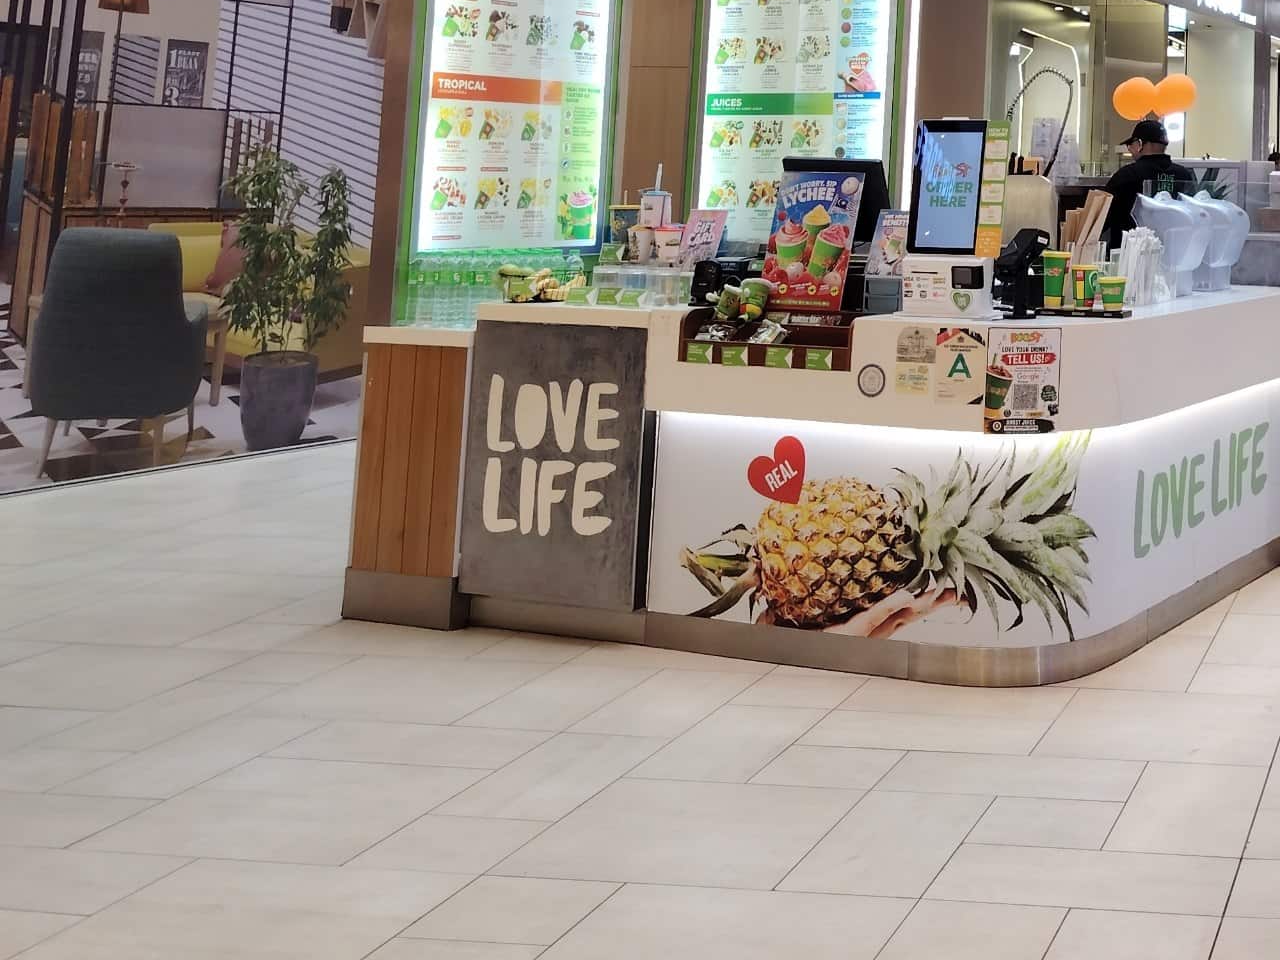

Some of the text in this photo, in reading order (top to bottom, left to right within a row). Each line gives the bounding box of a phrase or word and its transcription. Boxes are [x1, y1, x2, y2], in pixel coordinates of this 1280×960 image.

[437, 77, 487, 92] TROPICAL
[710, 98, 743, 107] JUICES
[925, 182, 974, 193] ORER
[783, 187, 836, 208] LYCHEE
[929, 196, 967, 208] HERE
[1010, 331, 1041, 343] BOOST
[947, 352, 972, 379] A
[1007, 353, 1045, 365] TELL US!
[1016, 373, 1040, 382] Google
[485, 373, 620, 453] LOVE
[764, 459, 798, 493] REAL
[482, 457, 617, 537] LIFE
[1133, 421, 1270, 558] LOVE LIFE
